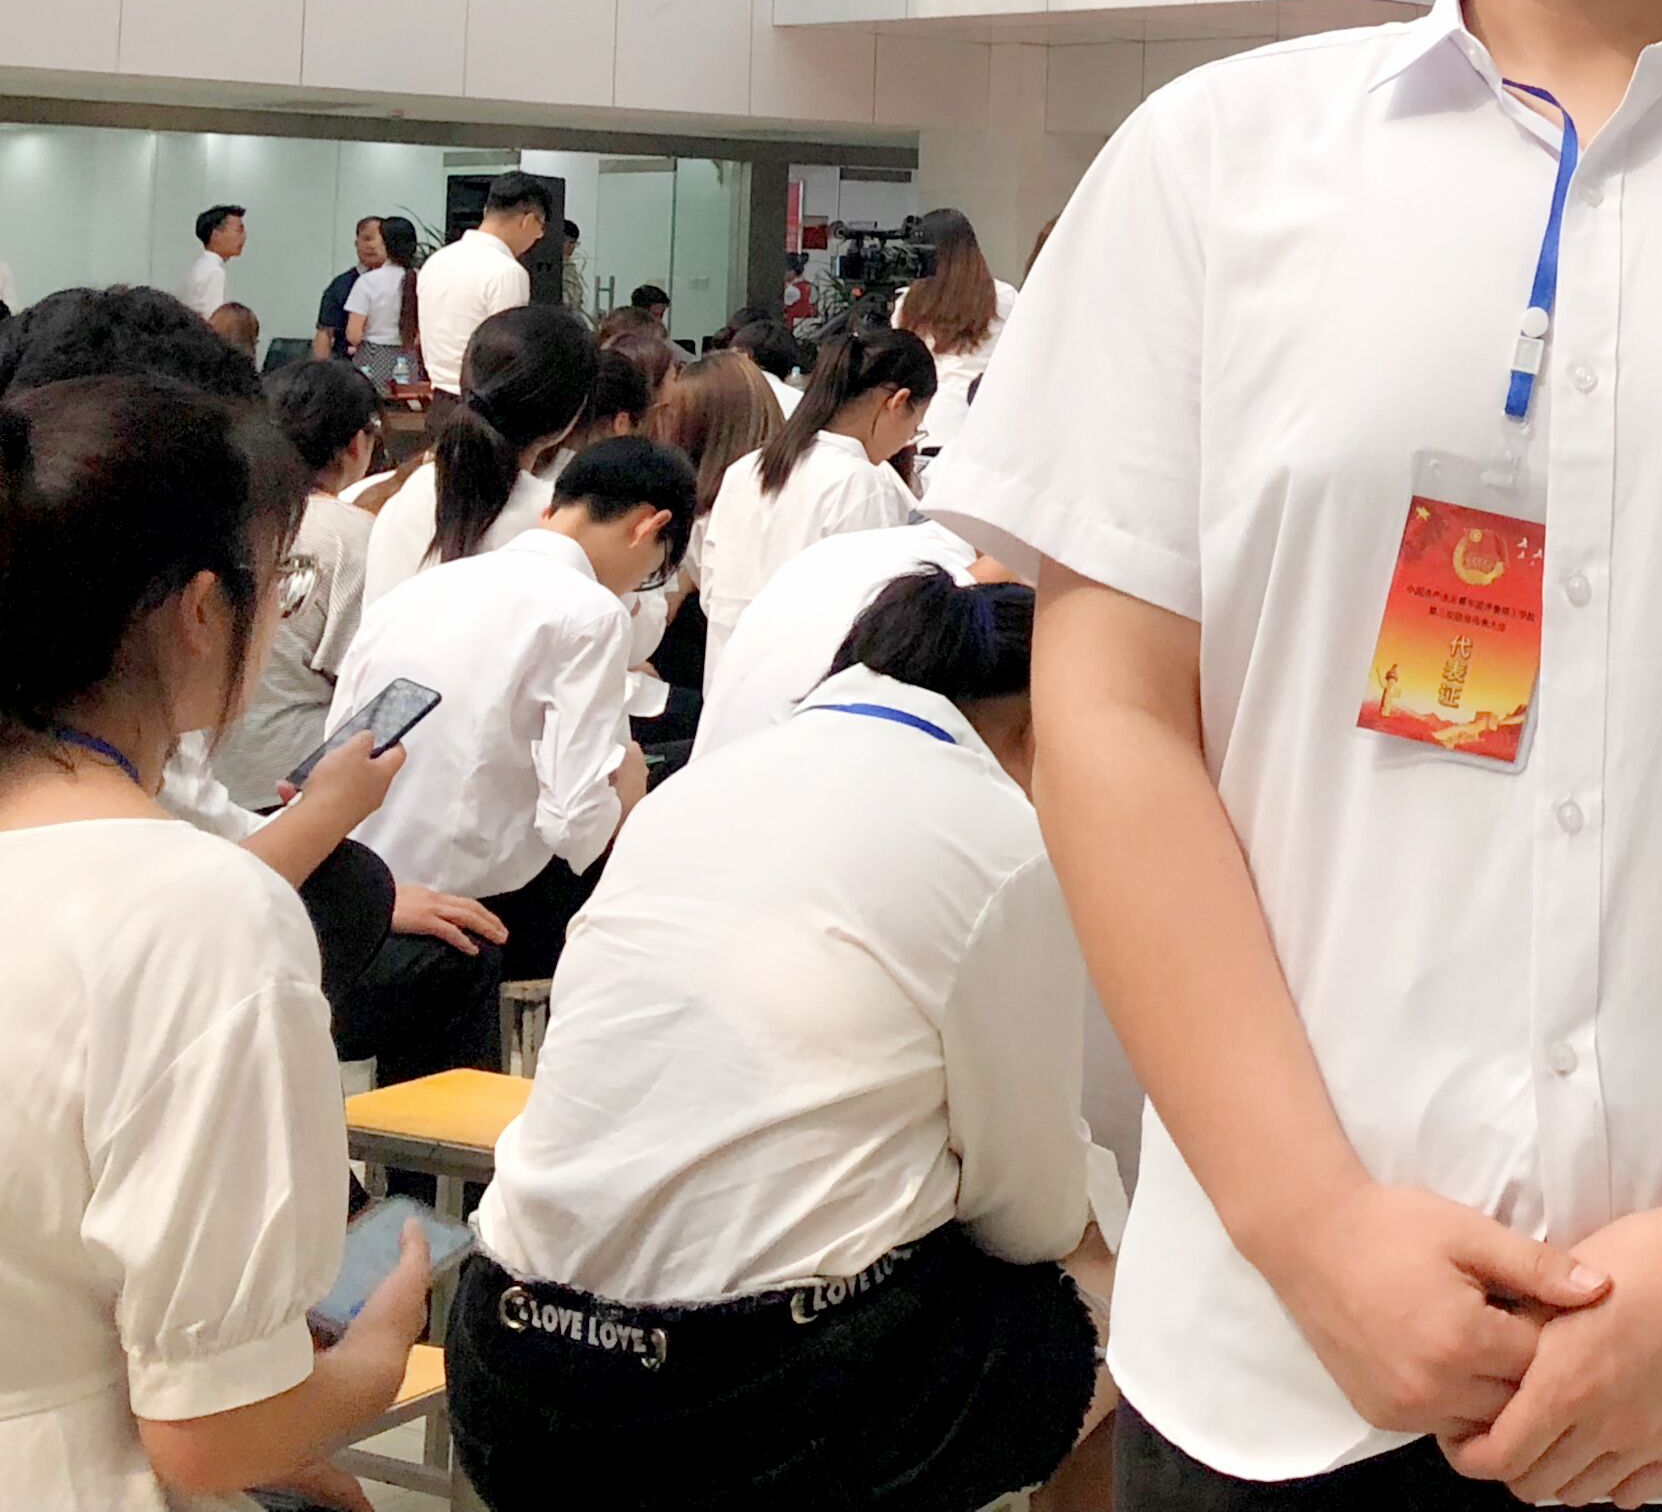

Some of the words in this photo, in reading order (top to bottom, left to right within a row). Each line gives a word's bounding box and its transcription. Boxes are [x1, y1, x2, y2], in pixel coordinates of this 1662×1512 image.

[1438, 634, 1473, 709] 代表证
[529, 1300, 583, 1341] LOVE
[587, 1316, 646, 1353] LOVE
